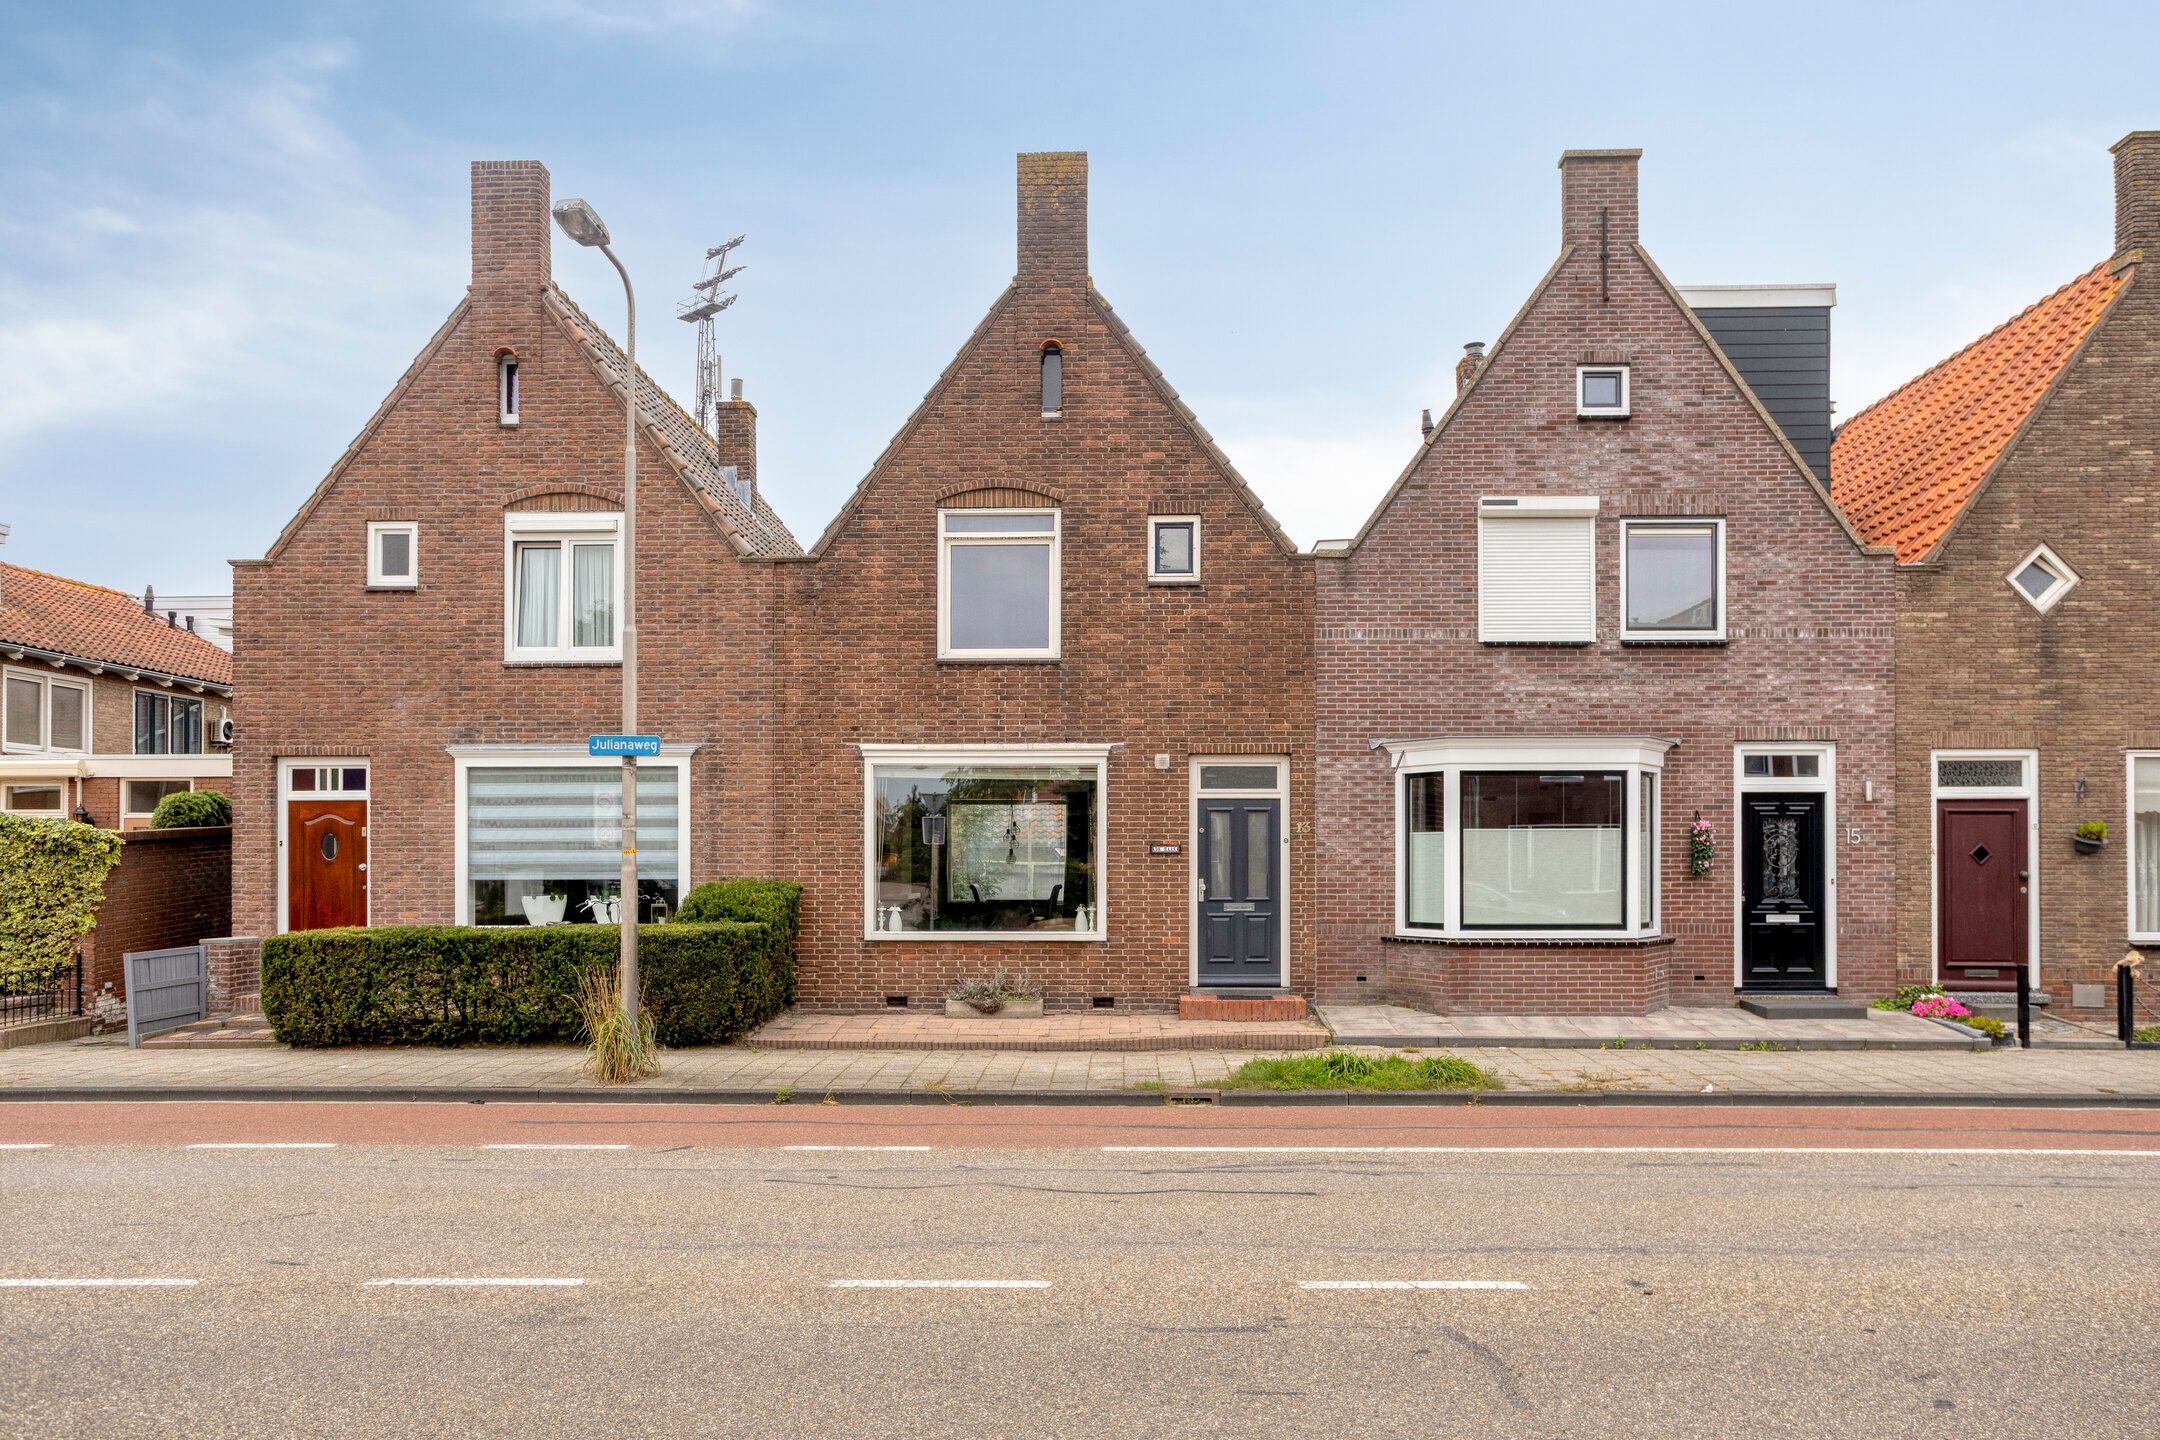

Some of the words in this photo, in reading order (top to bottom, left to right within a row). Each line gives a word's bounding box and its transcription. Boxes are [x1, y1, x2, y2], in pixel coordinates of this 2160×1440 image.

[592, 739, 657, 753] Julianaweg
[1296, 821, 1310, 833] 13
[1846, 828, 1860, 844] 15
